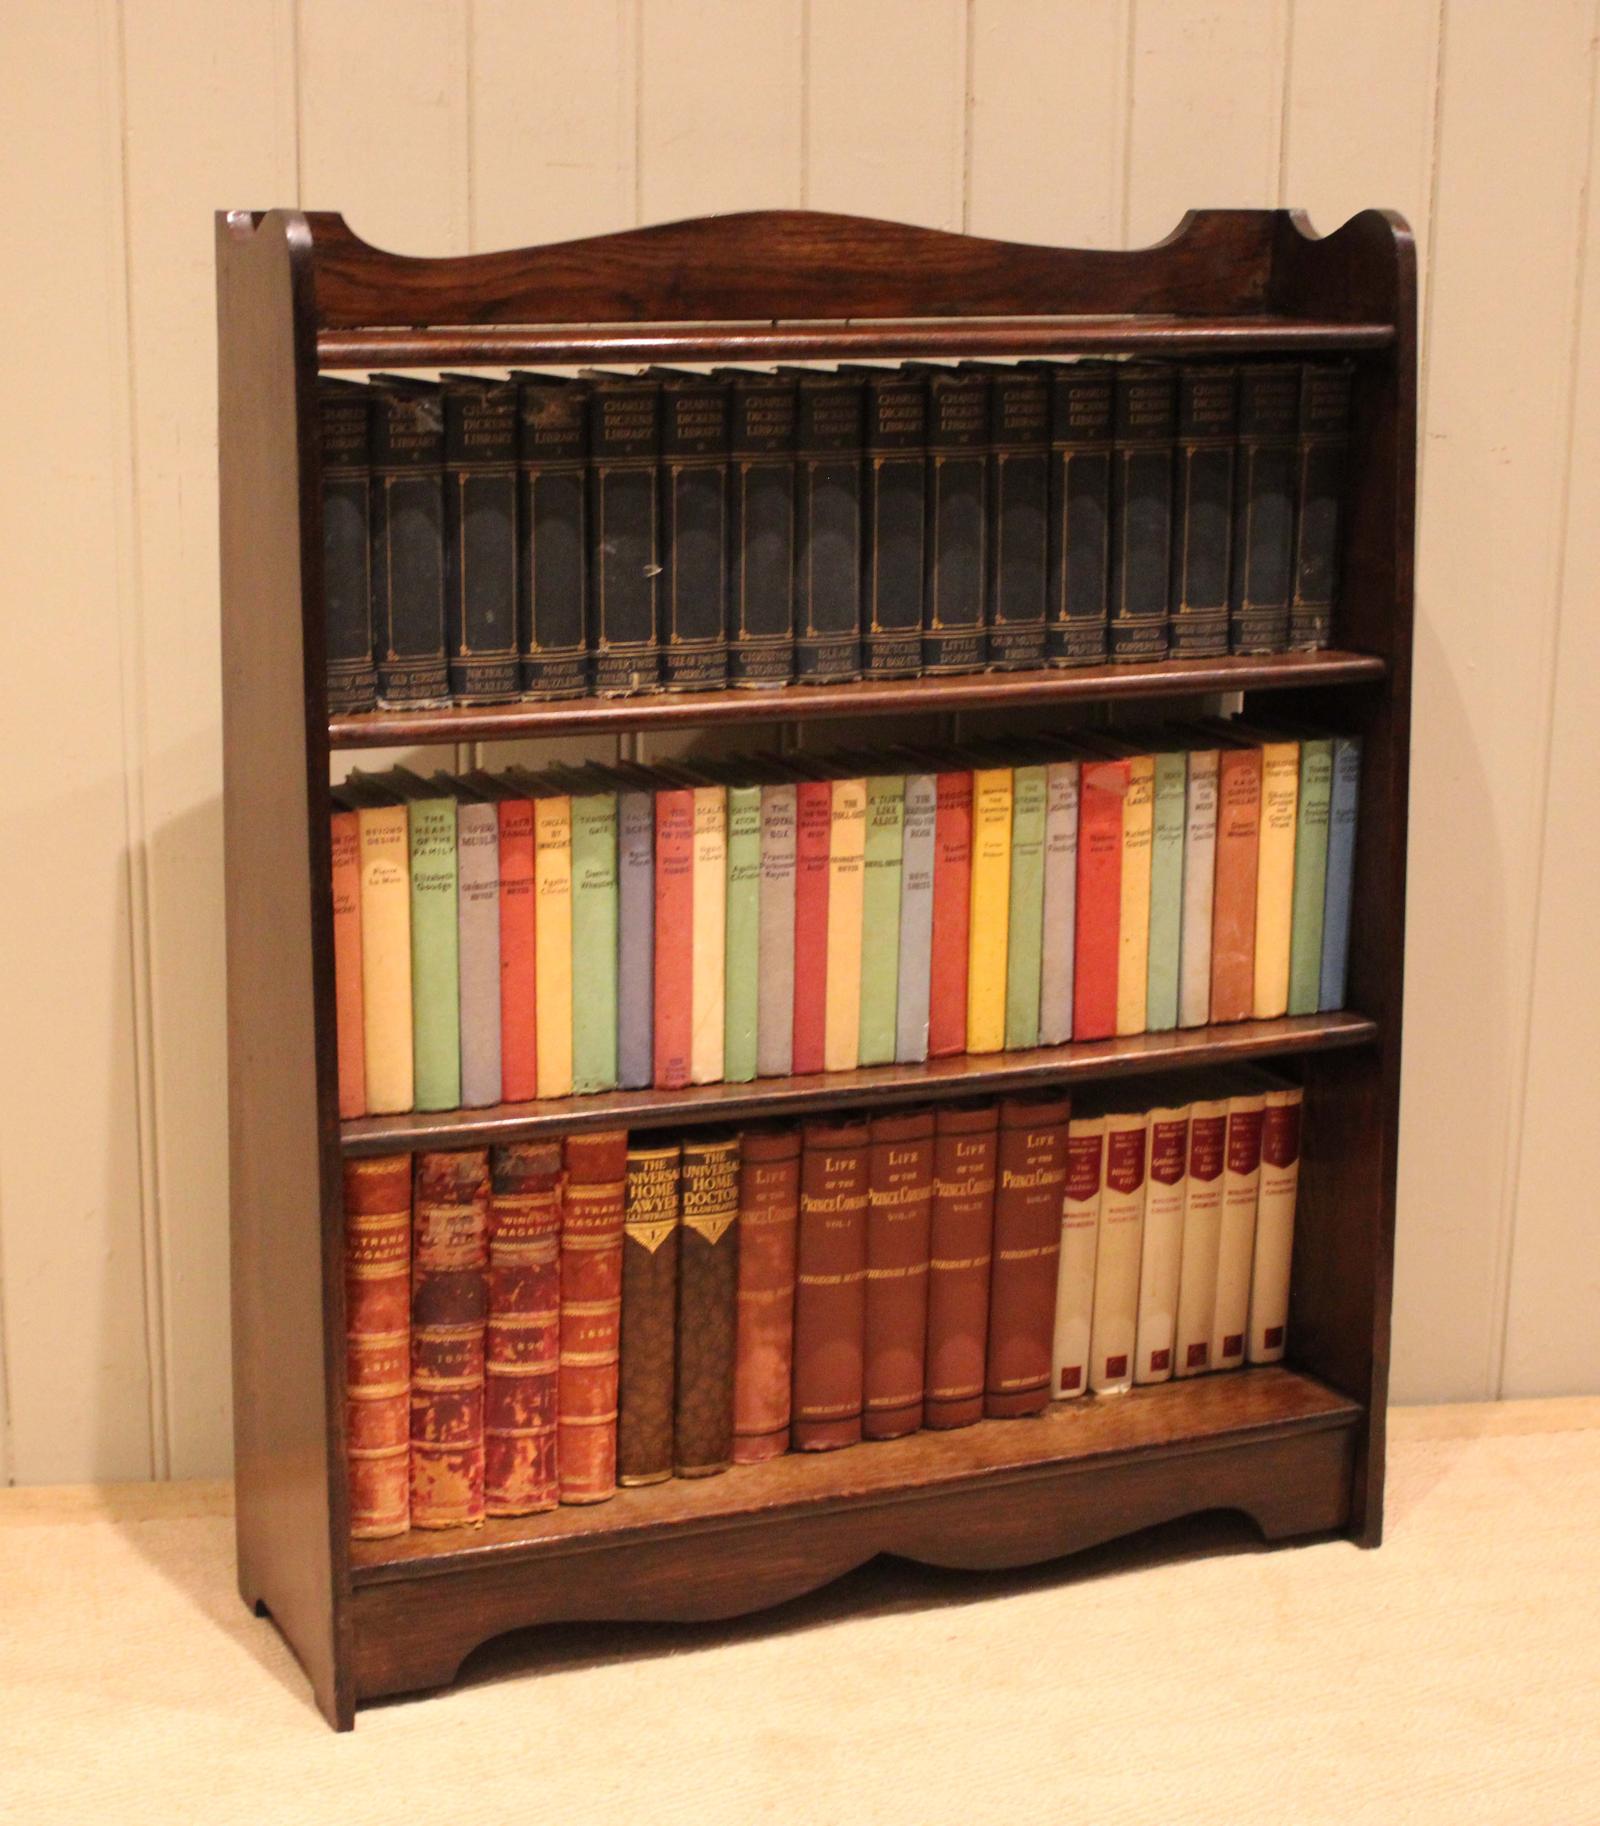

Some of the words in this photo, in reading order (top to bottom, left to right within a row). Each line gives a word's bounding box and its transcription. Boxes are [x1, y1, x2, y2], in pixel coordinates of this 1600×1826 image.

[868, 796, 877, 806] A
[771, 803, 790, 813] THE
[875, 805, 898, 816] LIKE
[423, 815, 444, 823] THE
[414, 825, 454, 835] HEART
[416, 836, 430, 846] OF
[432, 836, 453, 845] THE
[413, 847, 456, 857] FAMILY
[704, 1151, 728, 1165] THE
[643, 1159, 667, 1172] THE
[692, 1174, 735, 1192] HOME
[630, 1182, 675, 1199] HOME
